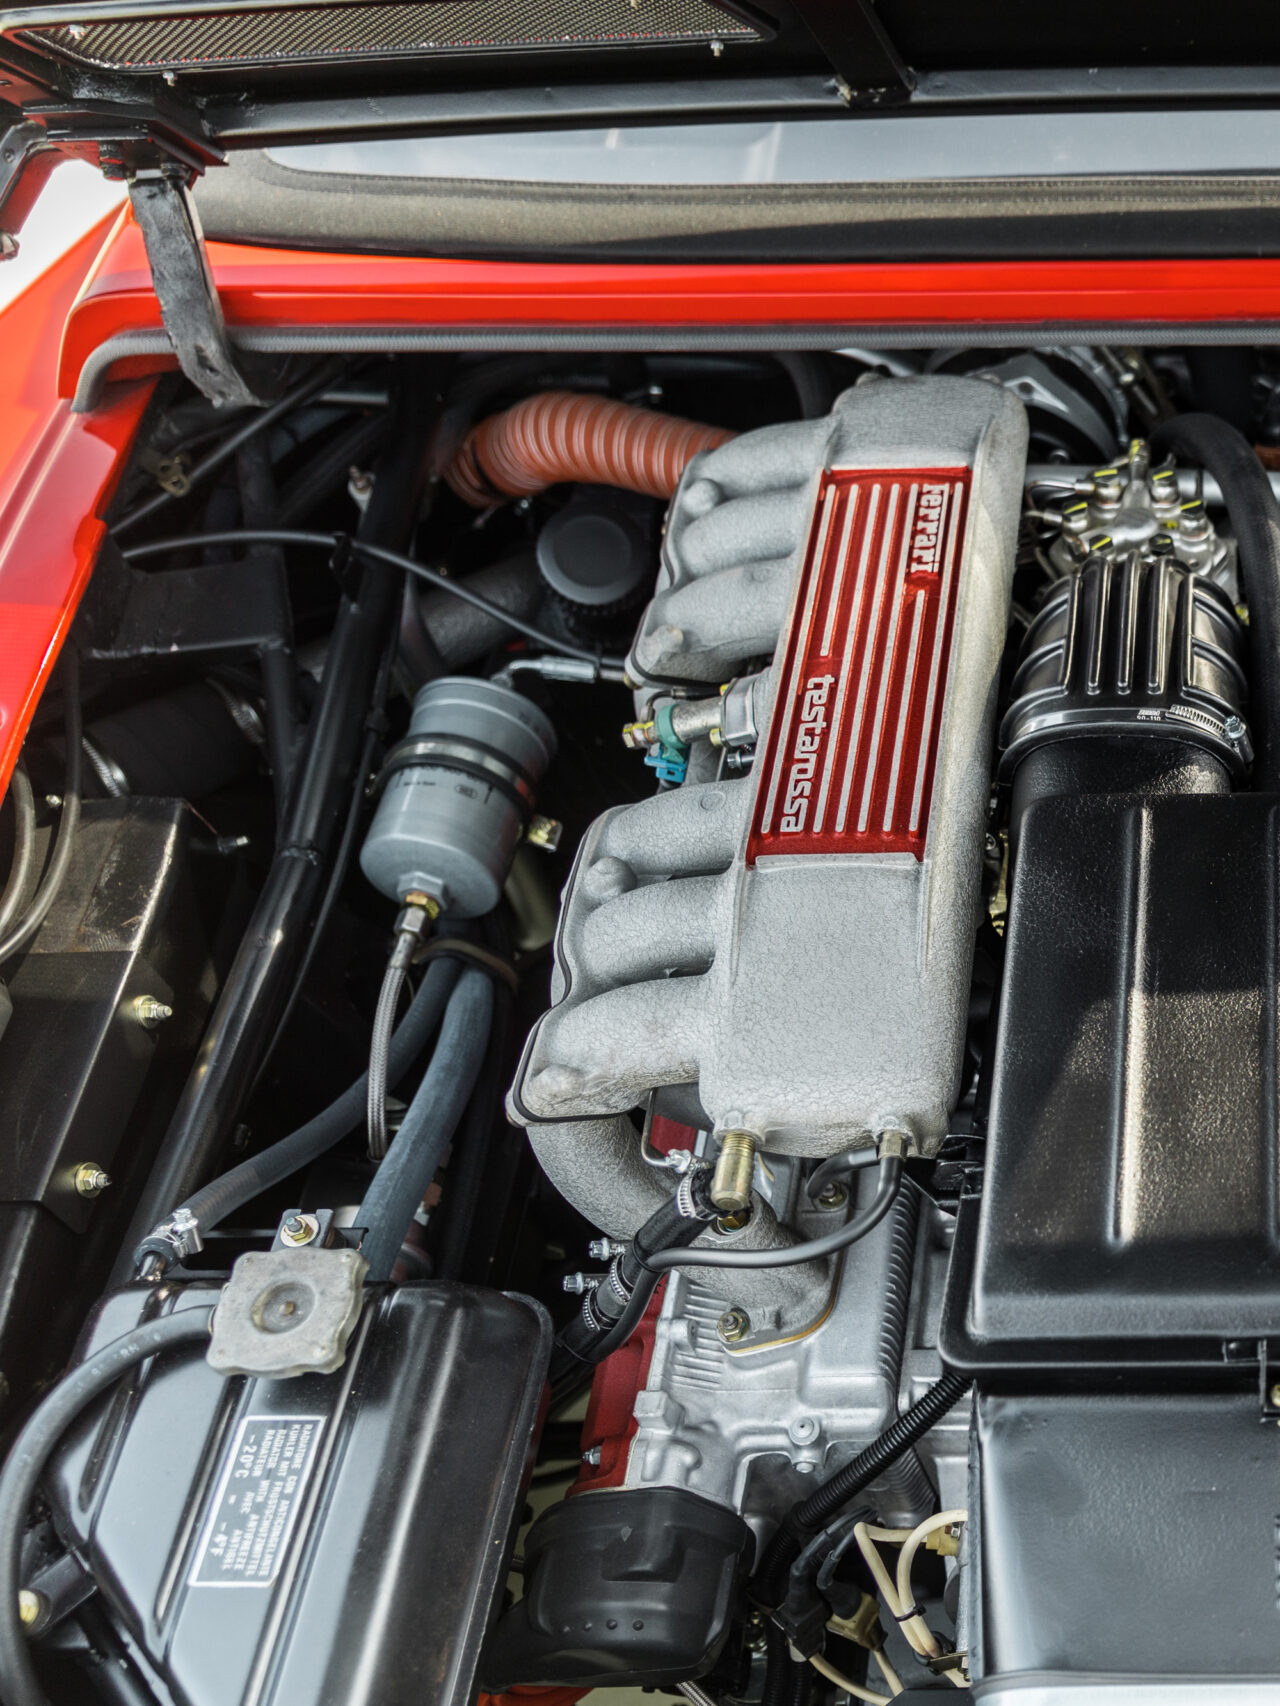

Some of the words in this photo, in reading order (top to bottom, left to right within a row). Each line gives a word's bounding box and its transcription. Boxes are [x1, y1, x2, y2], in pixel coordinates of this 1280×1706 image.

[909, 482, 950, 577] Ferrari
[780, 673, 835, 834] testarossa
[251, 1429, 276, 1477] RADIATEUR
[266, 1429, 287, 1469] RADIATOR
[277, 1460, 290, 1477] MIT
[291, 1424, 313, 1470] RADIATORE
[240, 1491, 255, 1515] AVEC
[255, 1479, 271, 1503] WITH
[283, 1475, 298, 1494] CON
[233, 1513, 260, 1571] ANTIFREEZE
[258, 1500, 290, 1577] ANTICONGELANTE
